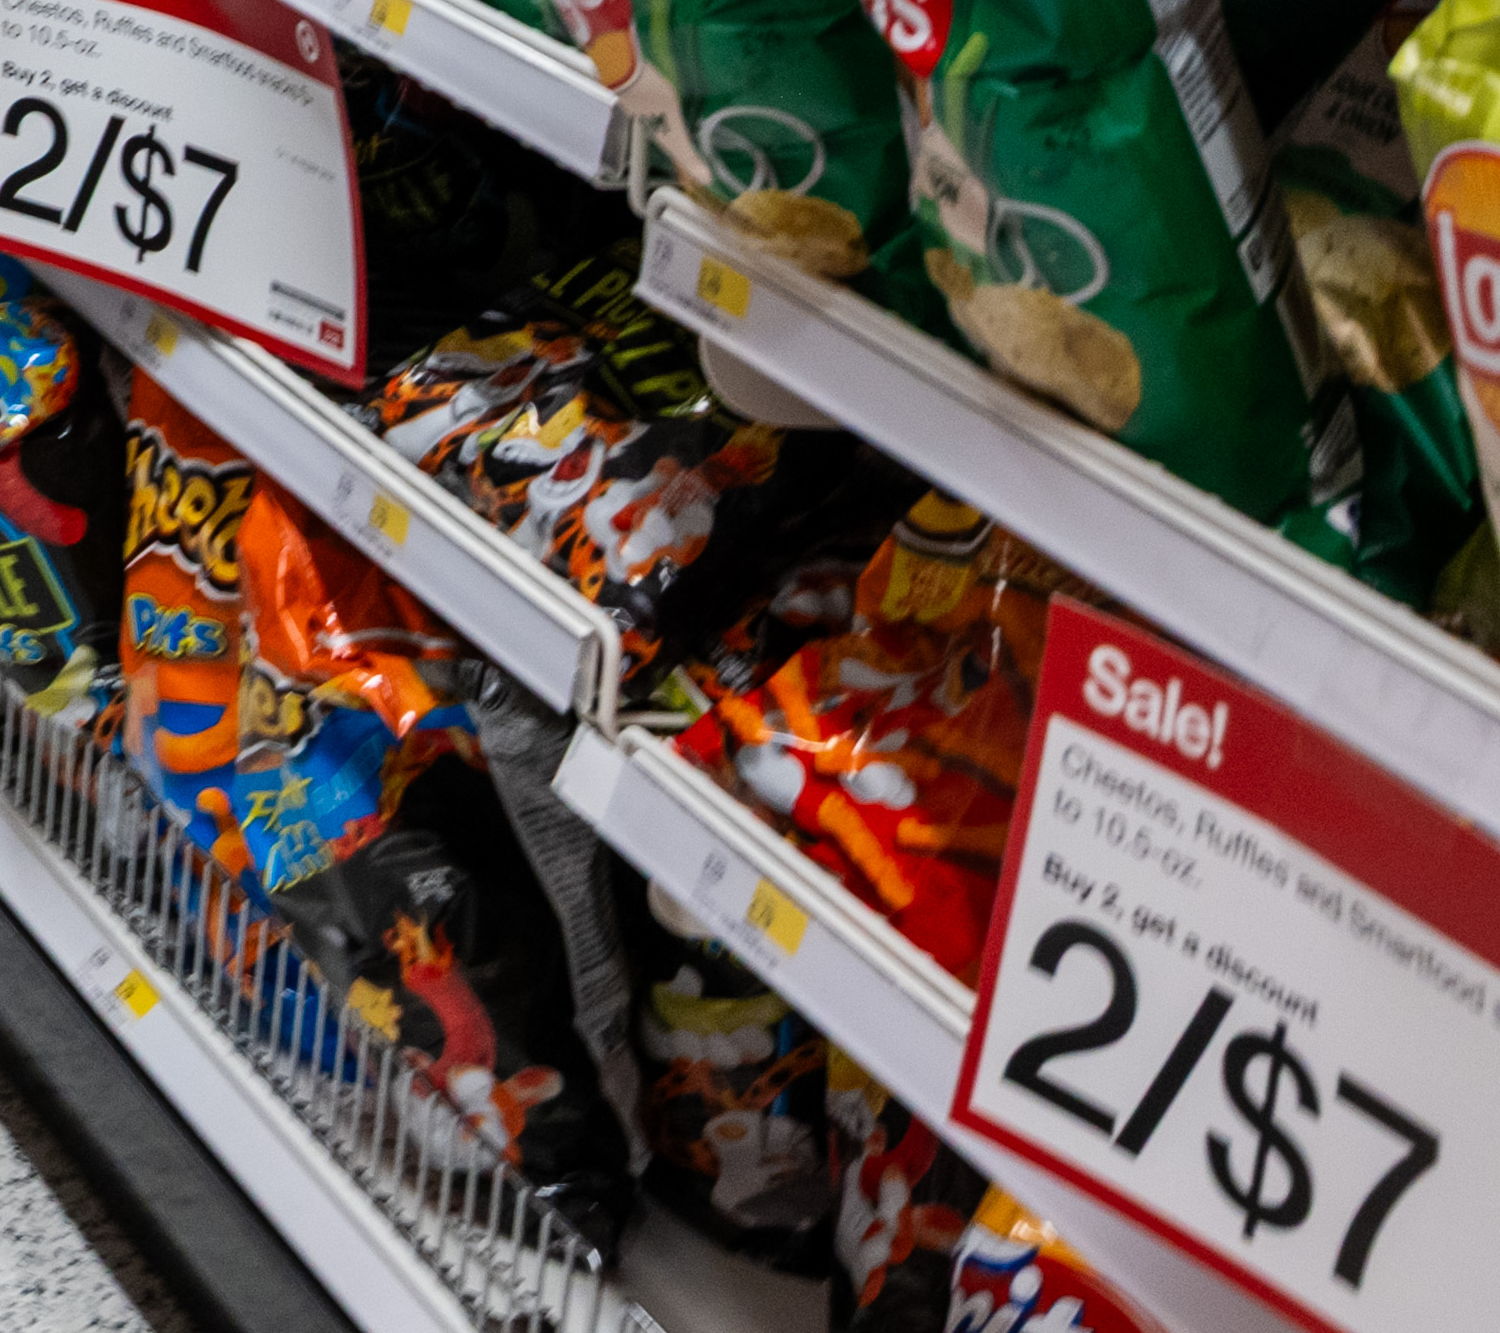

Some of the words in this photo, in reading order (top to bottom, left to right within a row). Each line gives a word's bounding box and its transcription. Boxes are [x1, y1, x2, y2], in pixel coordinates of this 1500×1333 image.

[1082, 644, 1231, 771] Sale!
[1041, 853, 1096, 907] Buy
[1204, 935, 1319, 1025] discount
[1001, 917, 1441, 1293] 2/$7
